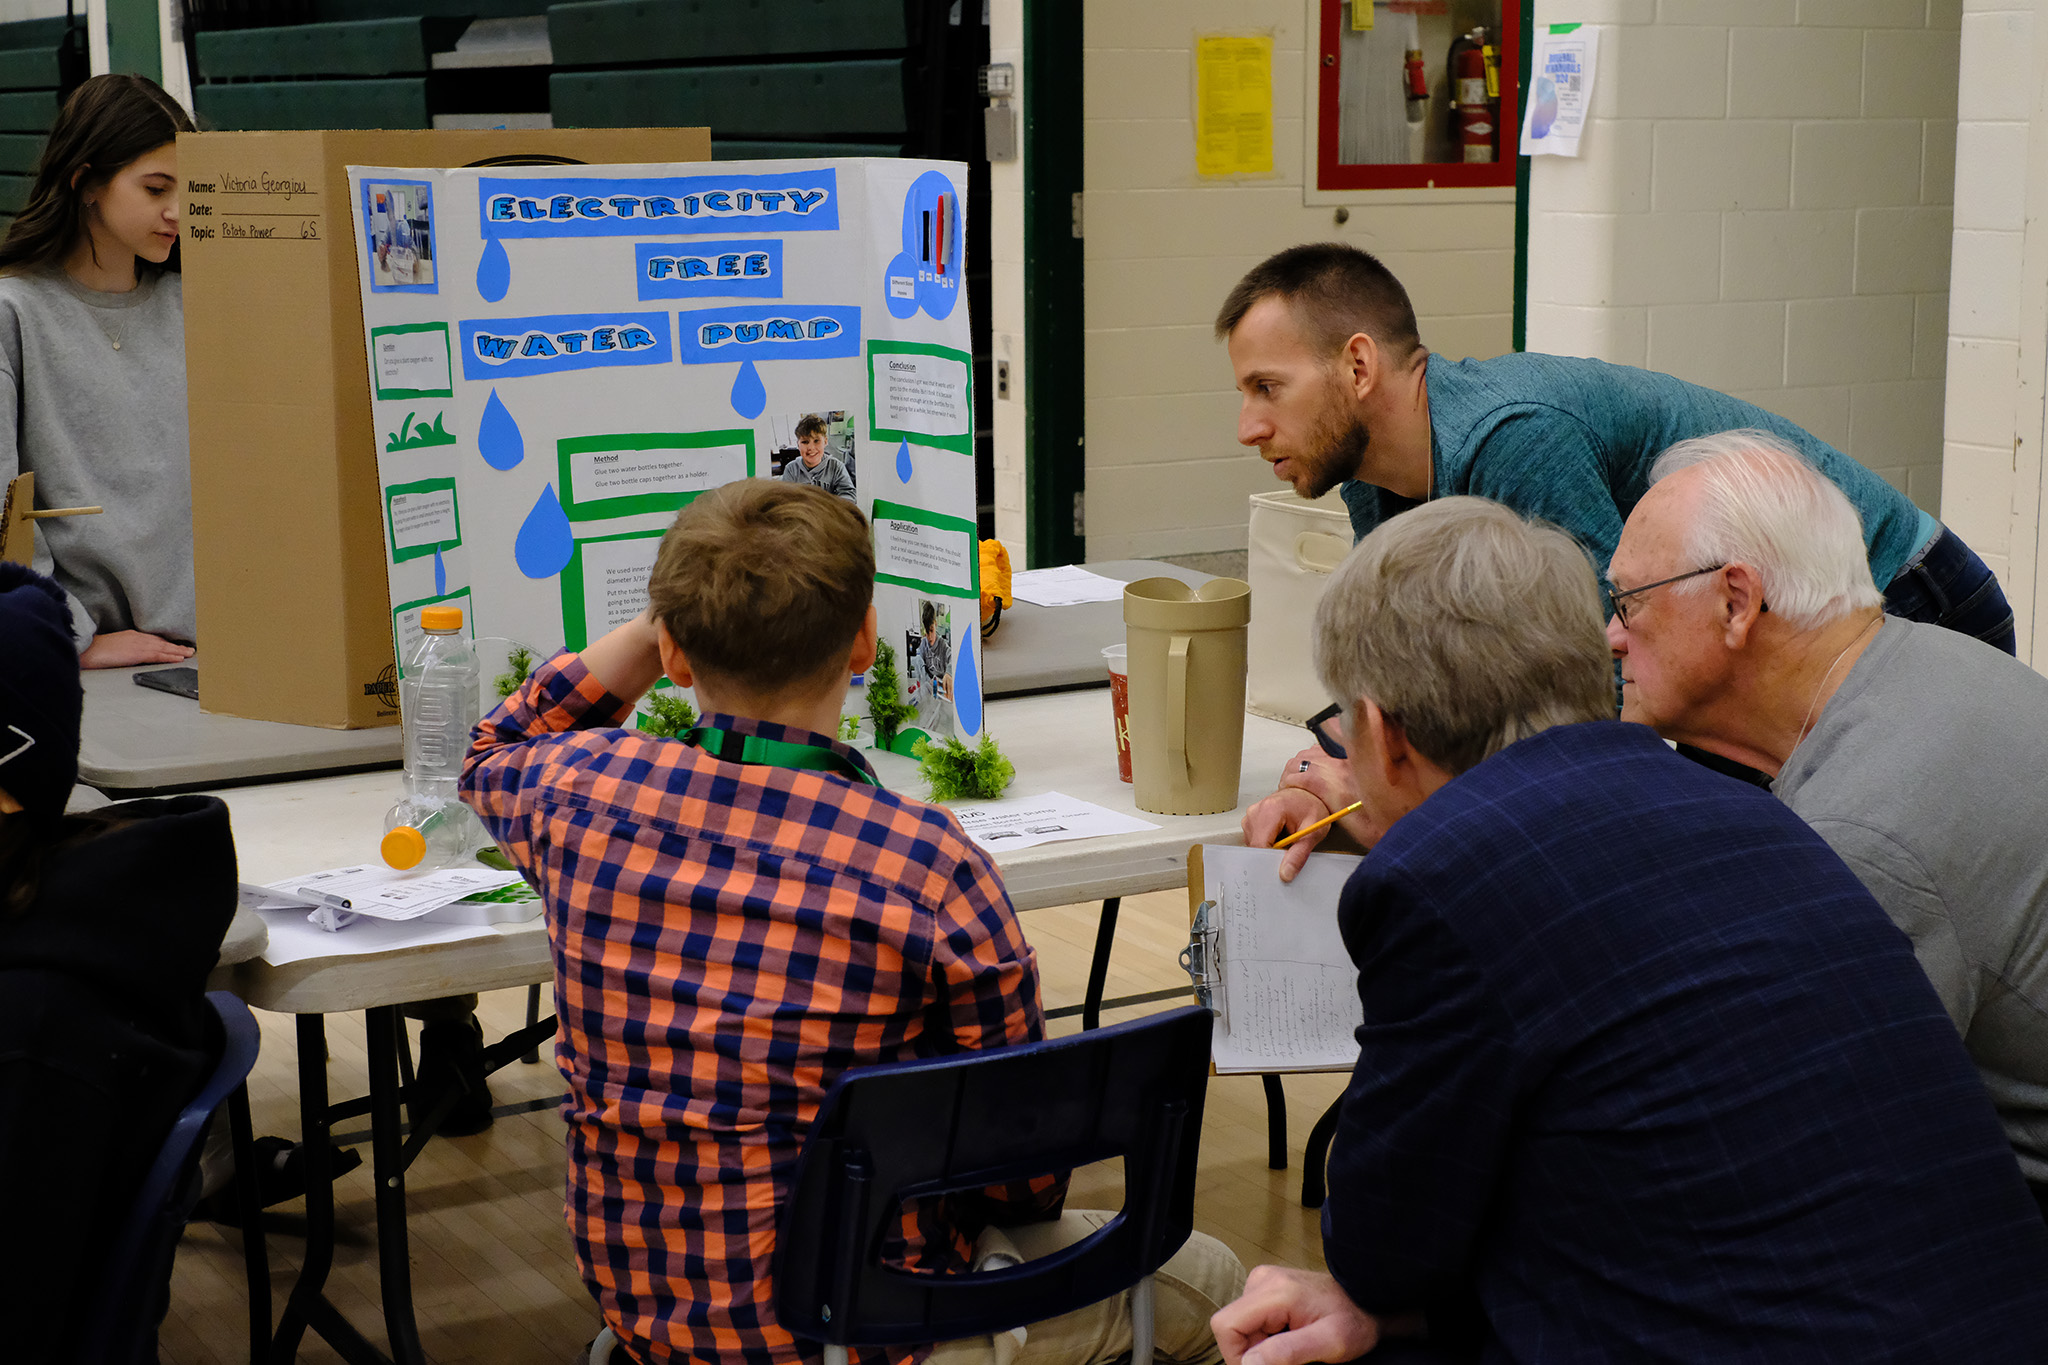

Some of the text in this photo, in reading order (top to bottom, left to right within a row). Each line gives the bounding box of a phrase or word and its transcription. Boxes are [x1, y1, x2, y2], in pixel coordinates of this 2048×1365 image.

[188, 180, 216, 193] Name:
[219, 172, 258, 192] Victoria
[189, 203, 213, 216] Date:
[491, 190, 824, 221] ELECTRICITY
[190, 225, 215, 241] Topic:
[222, 222, 247, 238] Potato
[250, 225, 276, 238] Power
[649, 253, 768, 279] FREE
[702, 318, 840, 345] PUMP
[476, 327, 656, 359] WATER
[889, 360, 916, 371] Conclusion
[594, 454, 619, 463] Method
[638, 462, 658, 471] bottles
[658, 461, 684, 471] together.
[622, 476, 638, 485] bottle
[652, 474, 677, 482] together
[689, 470, 710, 478] holder.
[890, 520, 918, 533] Application
[364, 681, 396, 696] PAPER
